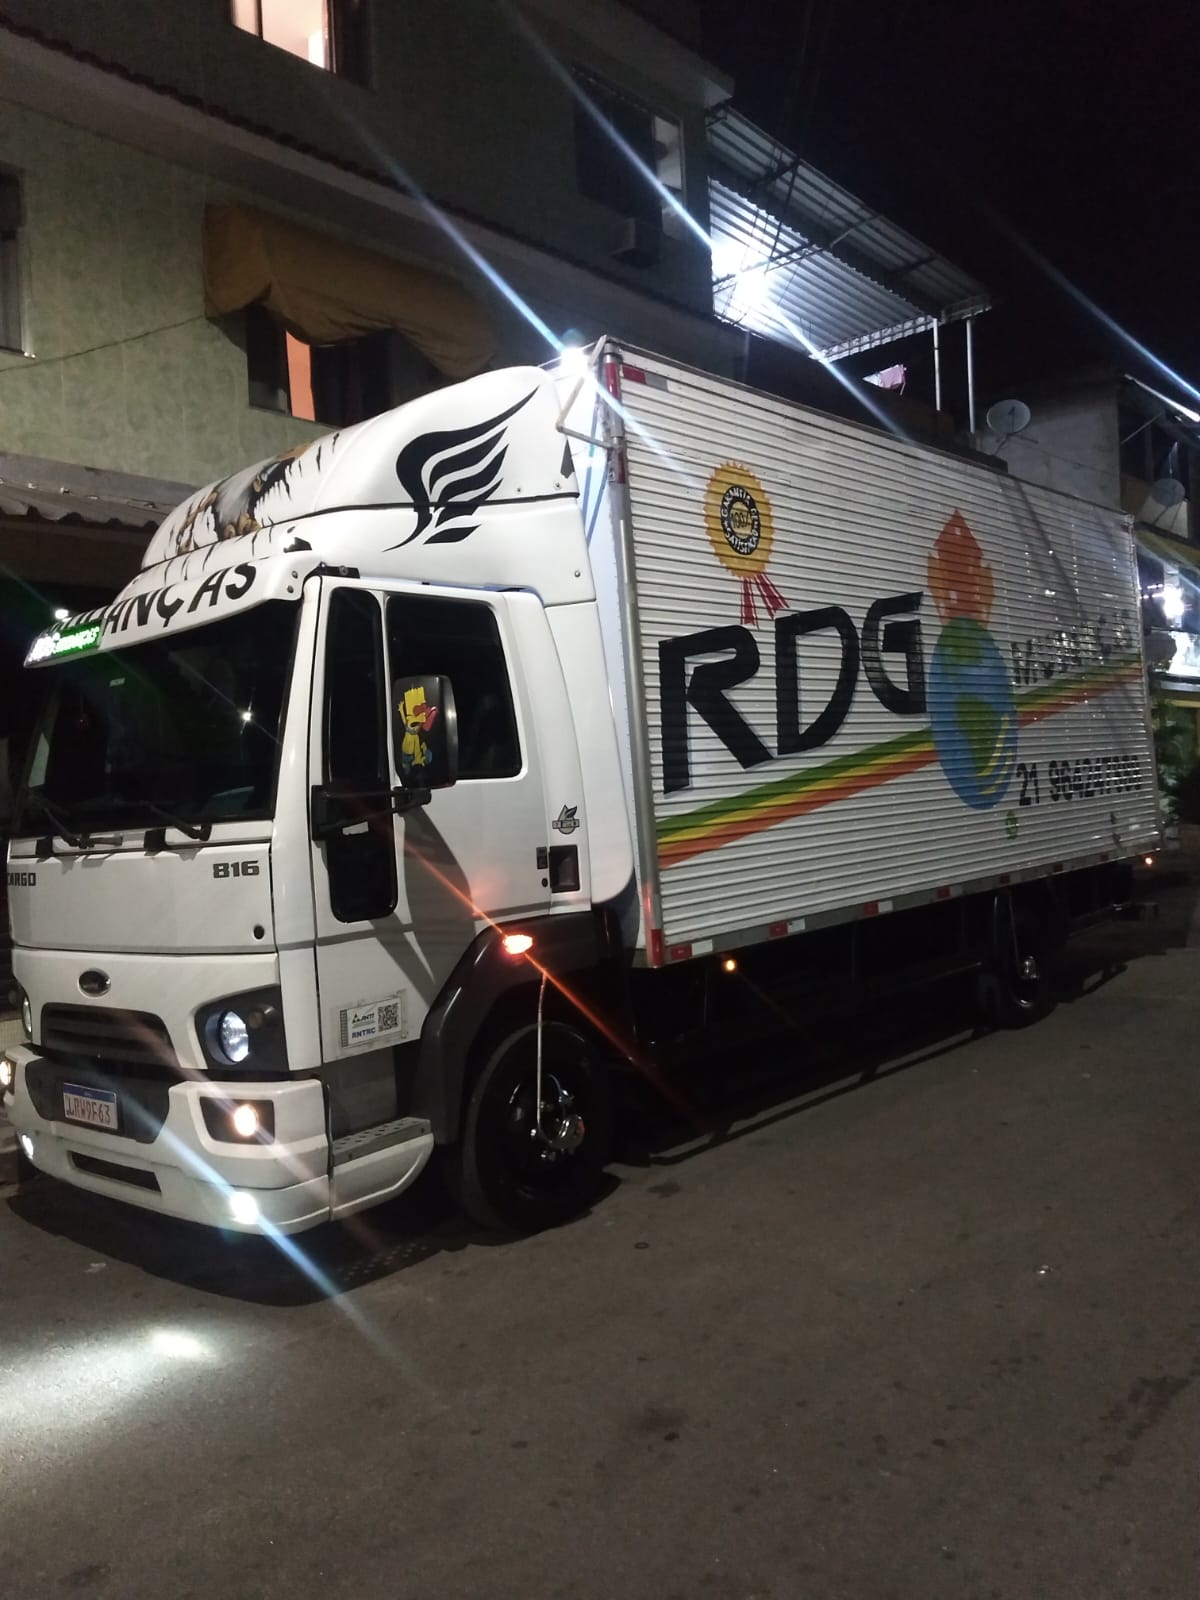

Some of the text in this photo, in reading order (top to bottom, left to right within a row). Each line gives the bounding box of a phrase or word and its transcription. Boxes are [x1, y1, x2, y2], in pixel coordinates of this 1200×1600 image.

[658, 591, 927, 794] RDG
[1016, 762, 1040, 806] 21
[213, 860, 260, 879] 816
